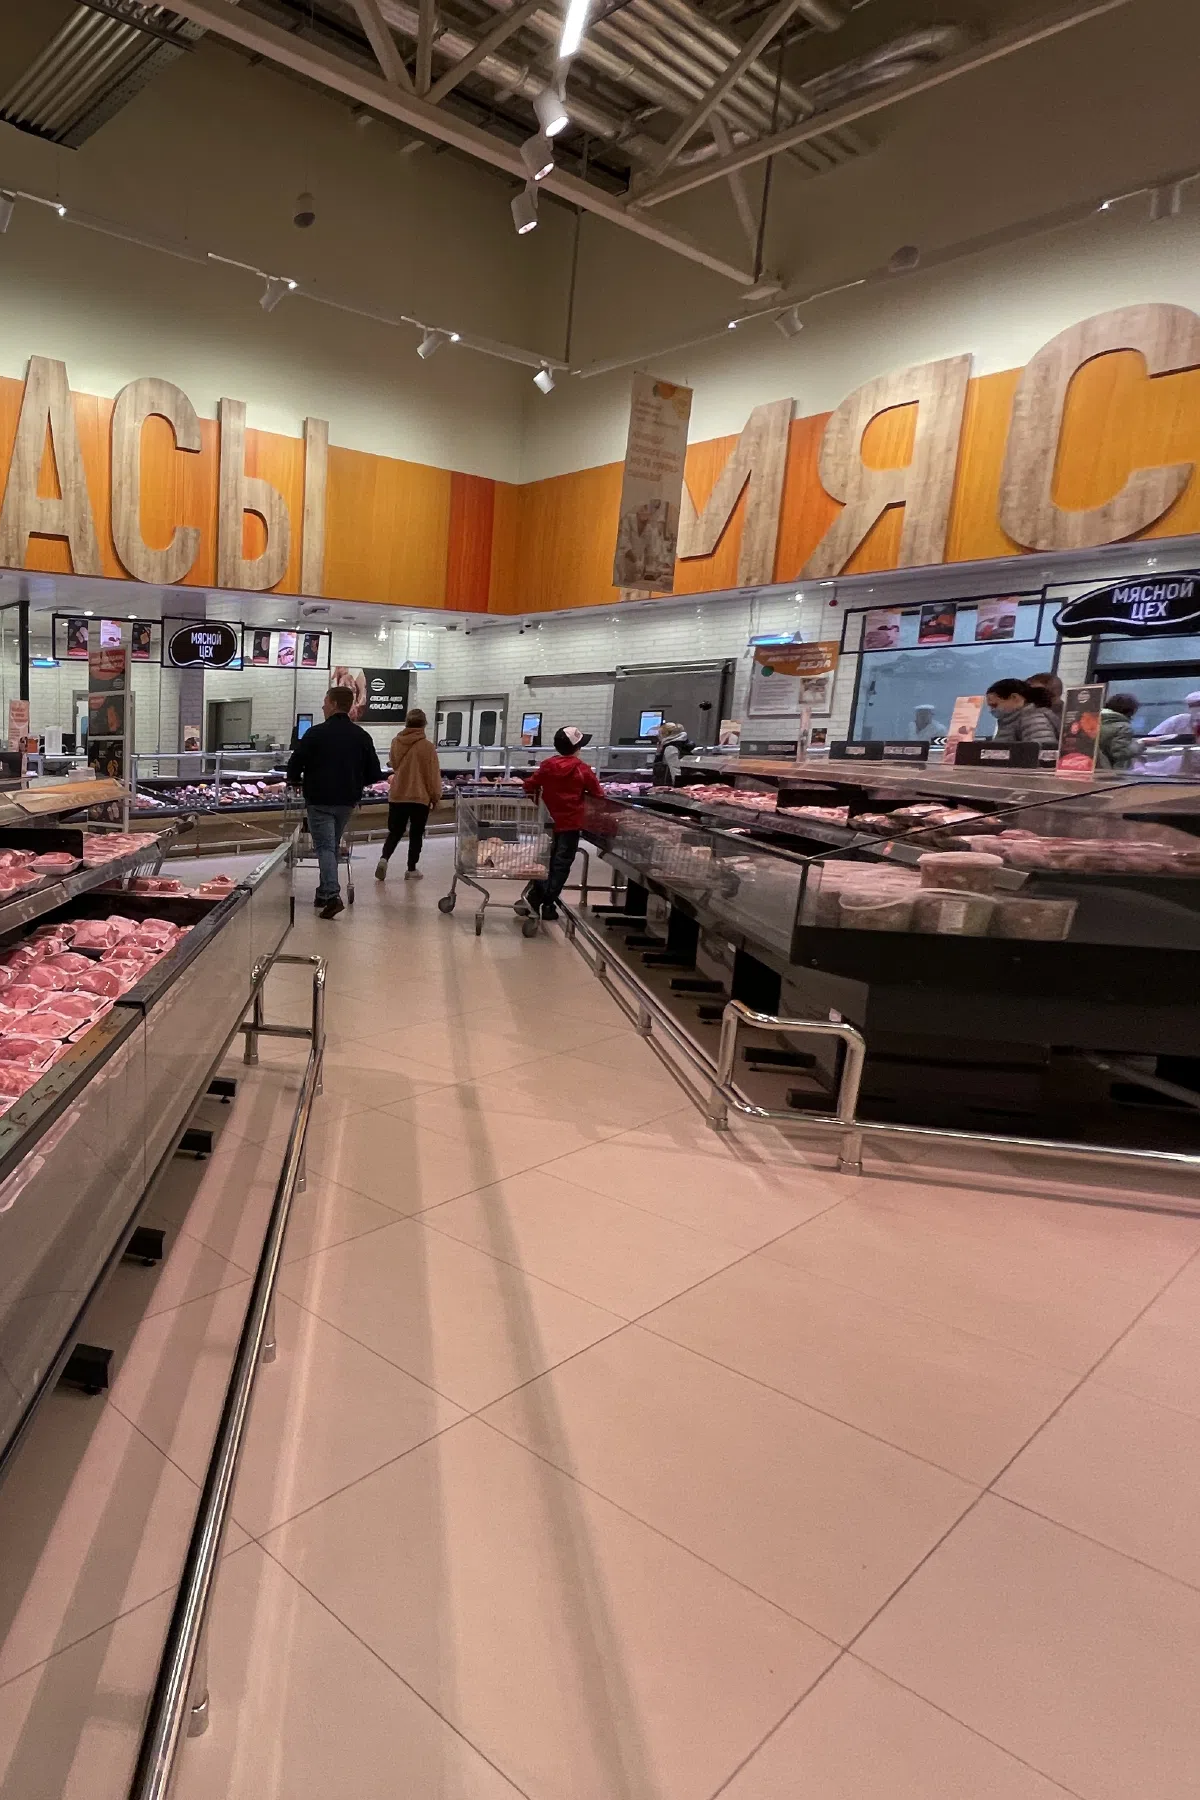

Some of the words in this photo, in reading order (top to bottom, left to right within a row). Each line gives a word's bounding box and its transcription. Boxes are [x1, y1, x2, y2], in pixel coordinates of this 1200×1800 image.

[1112, 579, 1195, 604] МЯСНОЙ
[1131, 600, 1169, 620] ЦЕХ
[191, 630, 222, 645] МЯСНОЙ
[199, 645, 214, 660] ЦЕХ
